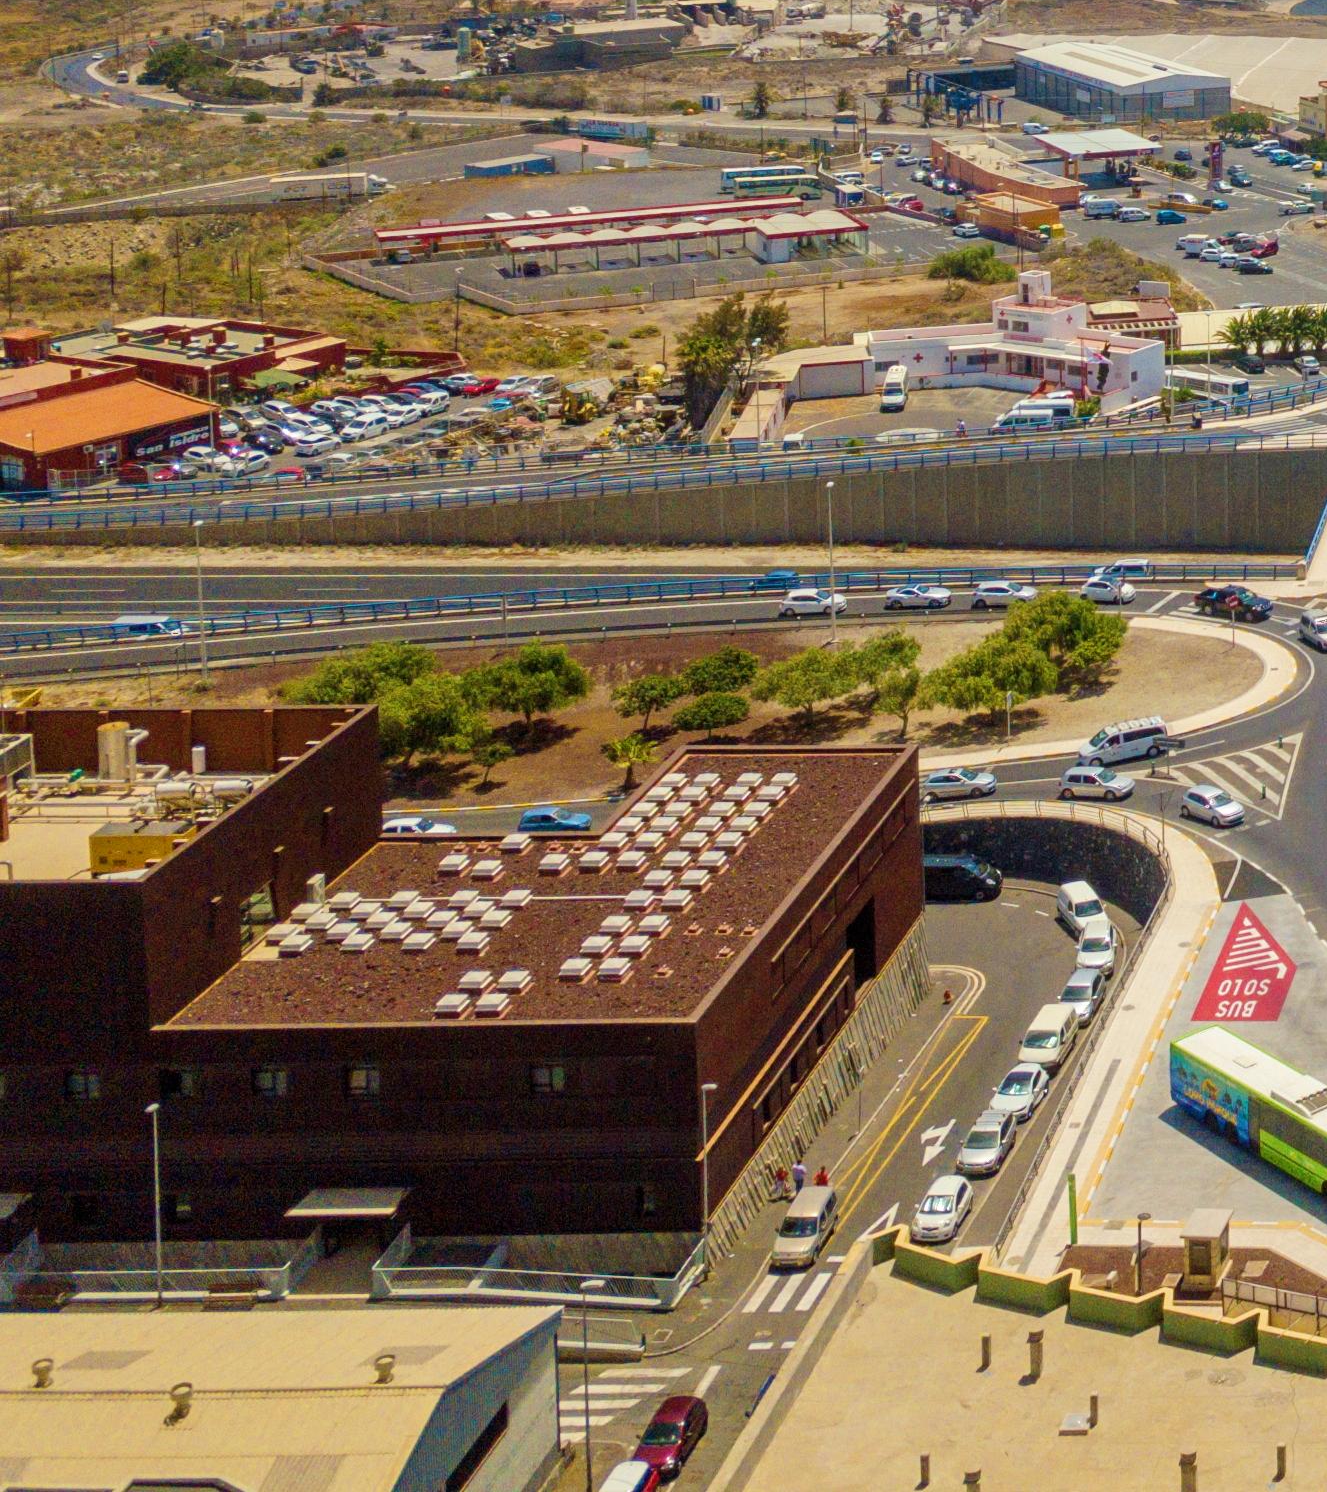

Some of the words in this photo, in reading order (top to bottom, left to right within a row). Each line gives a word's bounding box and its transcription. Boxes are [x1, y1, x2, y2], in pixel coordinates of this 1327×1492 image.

[135, 444, 164, 457] San
[169, 432, 210, 448] Isidro
[1217, 978, 1272, 997] SOLO
[1215, 1000, 1258, 1018] BUS
